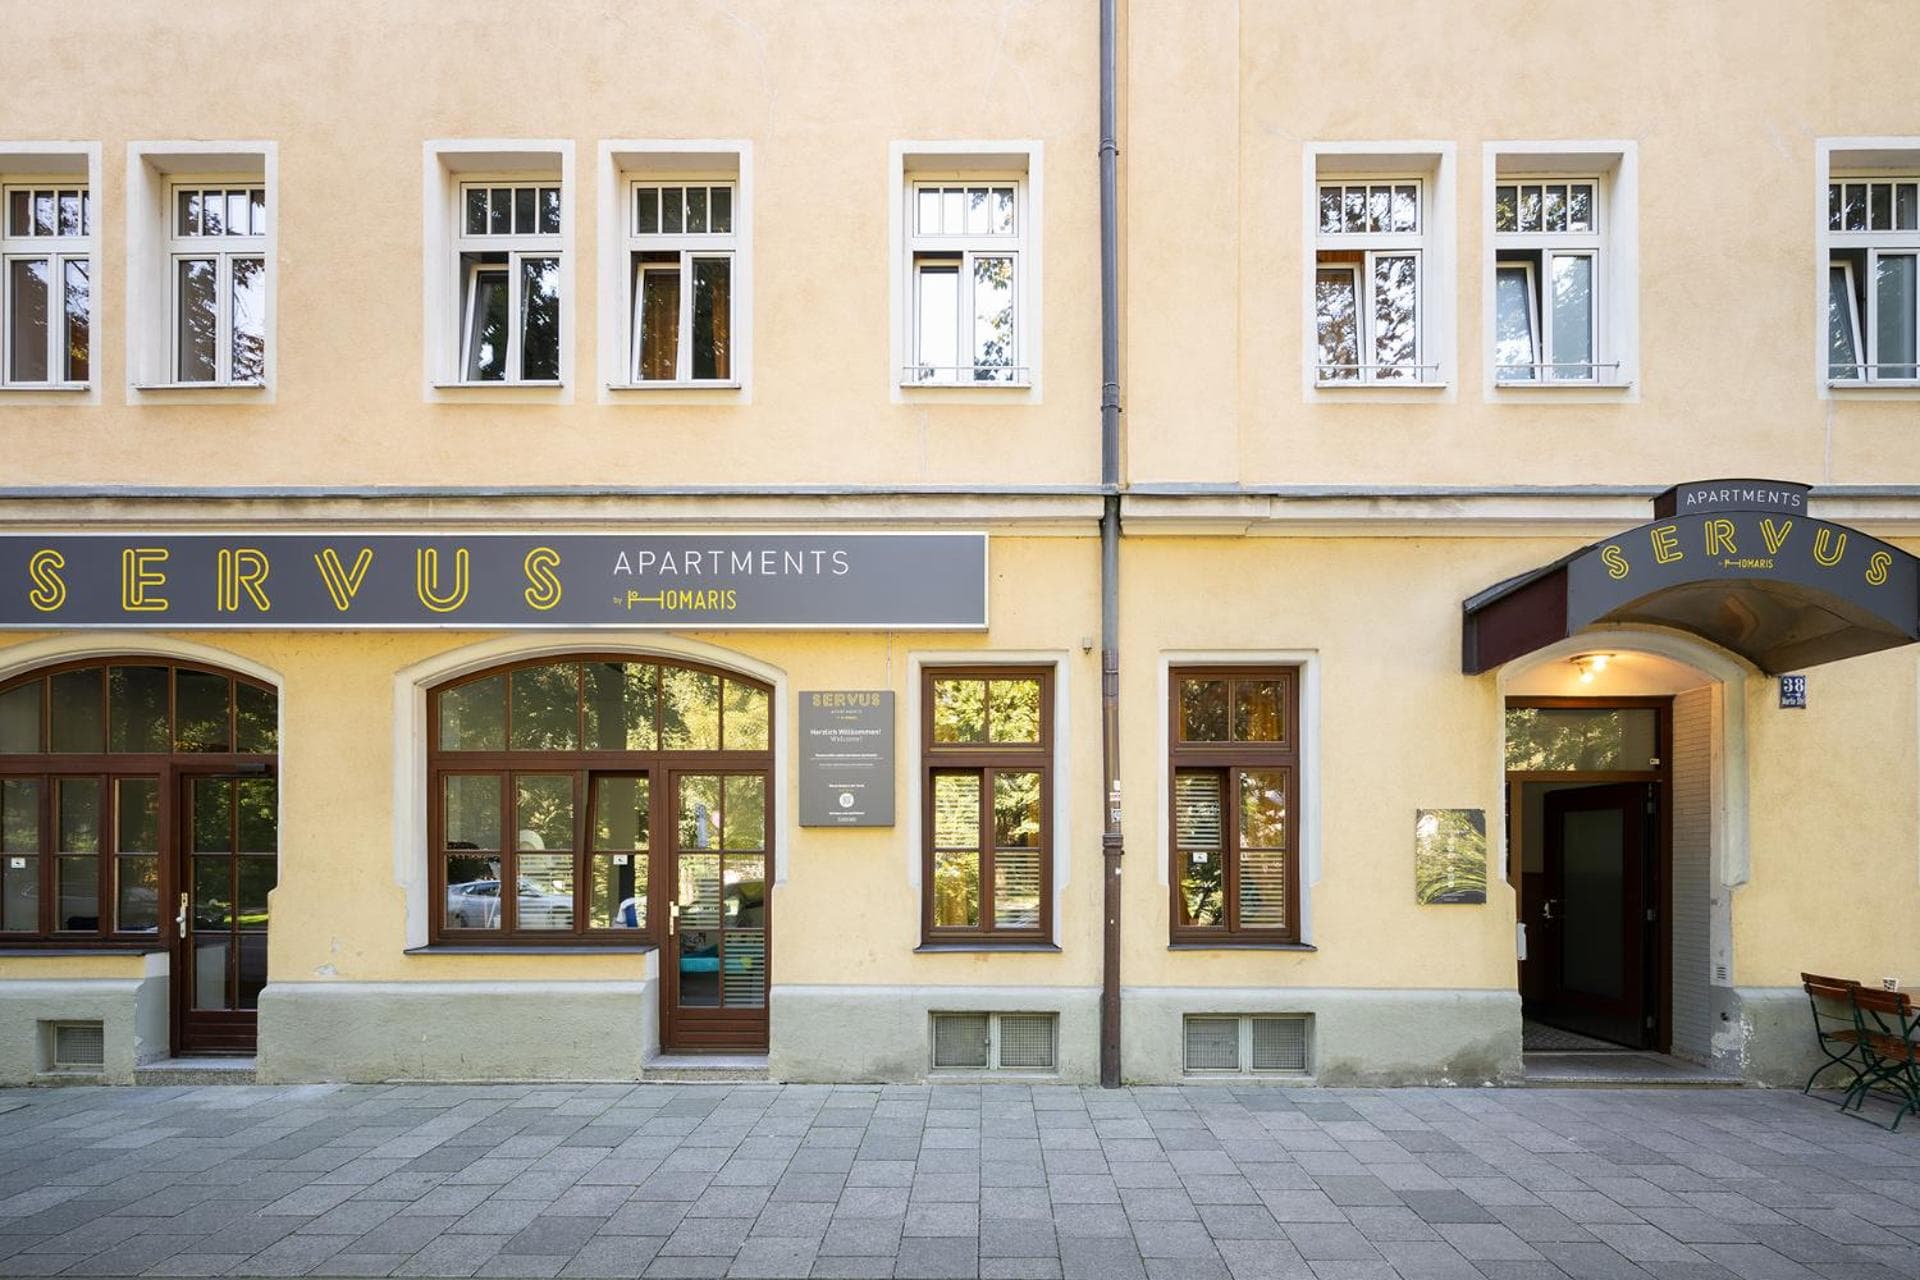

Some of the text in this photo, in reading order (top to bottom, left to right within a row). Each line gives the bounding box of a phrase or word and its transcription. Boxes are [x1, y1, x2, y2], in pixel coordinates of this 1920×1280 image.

[1686, 488, 1801, 507] APARTMENTS
[1601, 518, 1892, 586] SERVUS
[613, 551, 849, 575] APARTMENTS
[29, 547, 563, 612] SERVUS
[627, 590, 738, 609] HOMARIS
[1783, 677, 1804, 693] 38
[812, 692, 880, 707] SERVUS
